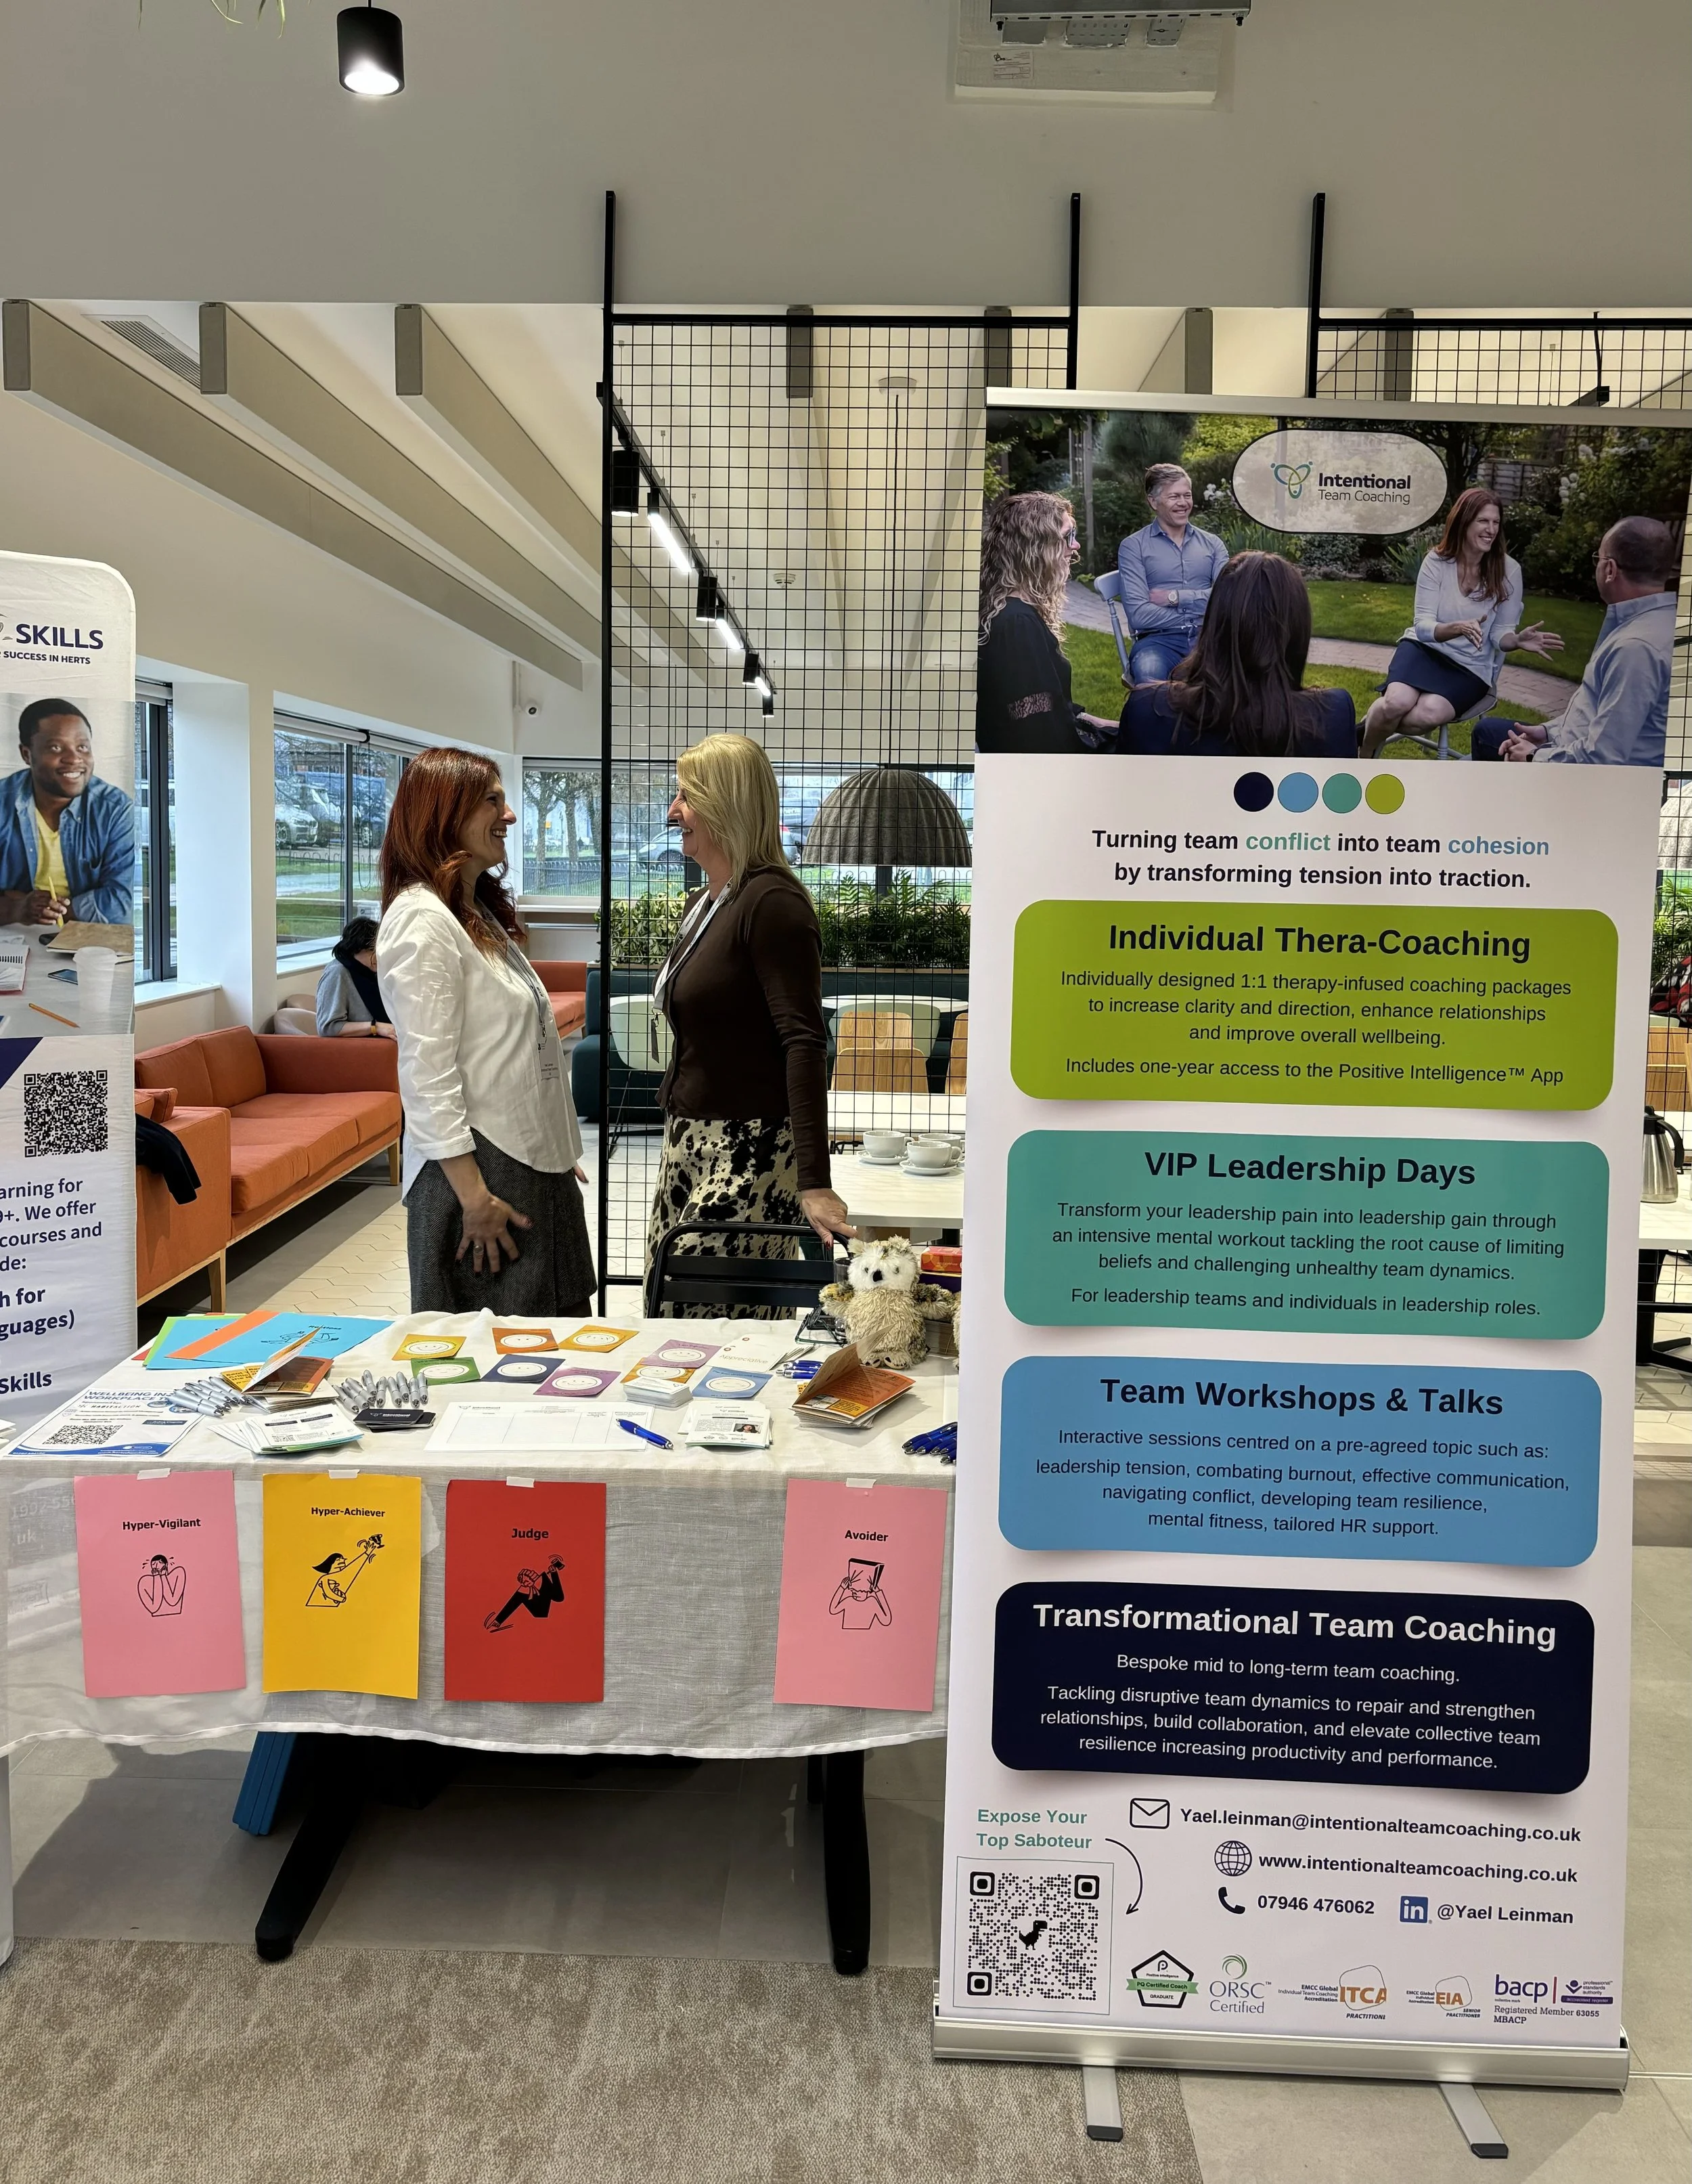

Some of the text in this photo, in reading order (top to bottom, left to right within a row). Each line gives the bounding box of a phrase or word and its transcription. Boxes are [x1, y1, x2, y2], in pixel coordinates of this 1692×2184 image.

[1318, 473, 1411, 489] Intentional
[1318, 489, 1410, 505] Team Coaching
[16, 624, 104, 650] SKILLS
[3, 651, 91, 664] SUCCESS IN HERTS
[1092, 830, 1549, 855] Turning team conflict into team cohesion
[1115, 862, 1530, 888] by transforming tension into traction.
[1110, 923, 1530, 964] Individual Thera-Coaching
[1061, 971, 1571, 999] Individually designed 1:1 therapy-infused coaching packages
[1067, 1058, 1134, 1073] Includes
[1140, 1062, 1214, 1078] one-year
[1220, 1063, 1280, 1076] access
[1285, 1064, 1301, 1077] to
[1307, 1063, 1333, 1078] the
[1339, 1063, 1404, 1079] Positive
[1530, 1068, 1563, 1086] App
[1145, 1152, 1475, 1189] VIP Leadership Days
[58, 1178, 83, 1193] for
[25, 1205, 51, 1221] We
[55, 1200, 96, 1217] offer
[1058, 1202, 1555, 1231] Transform your leadership pain into leadership gain through
[0, 1221, 102, 1248] courses and
[16, 1288, 45, 1305] for
[1072, 1288, 1540, 1317] For leadership teams and individuals in leadership roles.
[719, 1354, 768, 1363] Appreciative
[0, 1372, 51, 1395] Skills
[1100, 1378, 1502, 1416] Team Workshops & Talks
[1060, 1430, 1548, 1458] Interactive sessions centred on a pre-agreed topic such as:
[311, 1506, 386, 1519] Hyper-Achiever
[122, 1516, 201, 1531] Hyper-Vigilant
[511, 1527, 549, 1542] Judge
[845, 1530, 889, 1542] Avoider
[1033, 1604, 1555, 1652] Transformational Team Coaching
[1117, 1655, 1459, 1685] Bespoke mid to long-term team coaching.
[1048, 1686, 1534, 1721] Tackling disruptive team dynamics to repair and strengthen
[978, 1809, 1087, 1826] Expose Your
[1180, 1809, 1581, 1842] Yael.leinman@intentionalteamcoaching.co.uk
[977, 1833, 1092, 1850] Top Saboteur
[1259, 1855, 1578, 1883] www.intentionalteamcoaching.co.uk
[1258, 1896, 1374, 1914] 07946 476062
[1438, 1904, 1574, 1923] @Yael Leinman
[1339, 1986, 1387, 2004] ITCA
[1435, 1992, 1463, 2005] EIA
[1494, 1974, 1548, 2003] bacp
[1209, 2000, 1264, 2013] Certified
[1494, 2005, 1538, 2015] Registered
[1540, 2007, 1574, 2016] Member
[1494, 2015, 1527, 2024] MBACP
